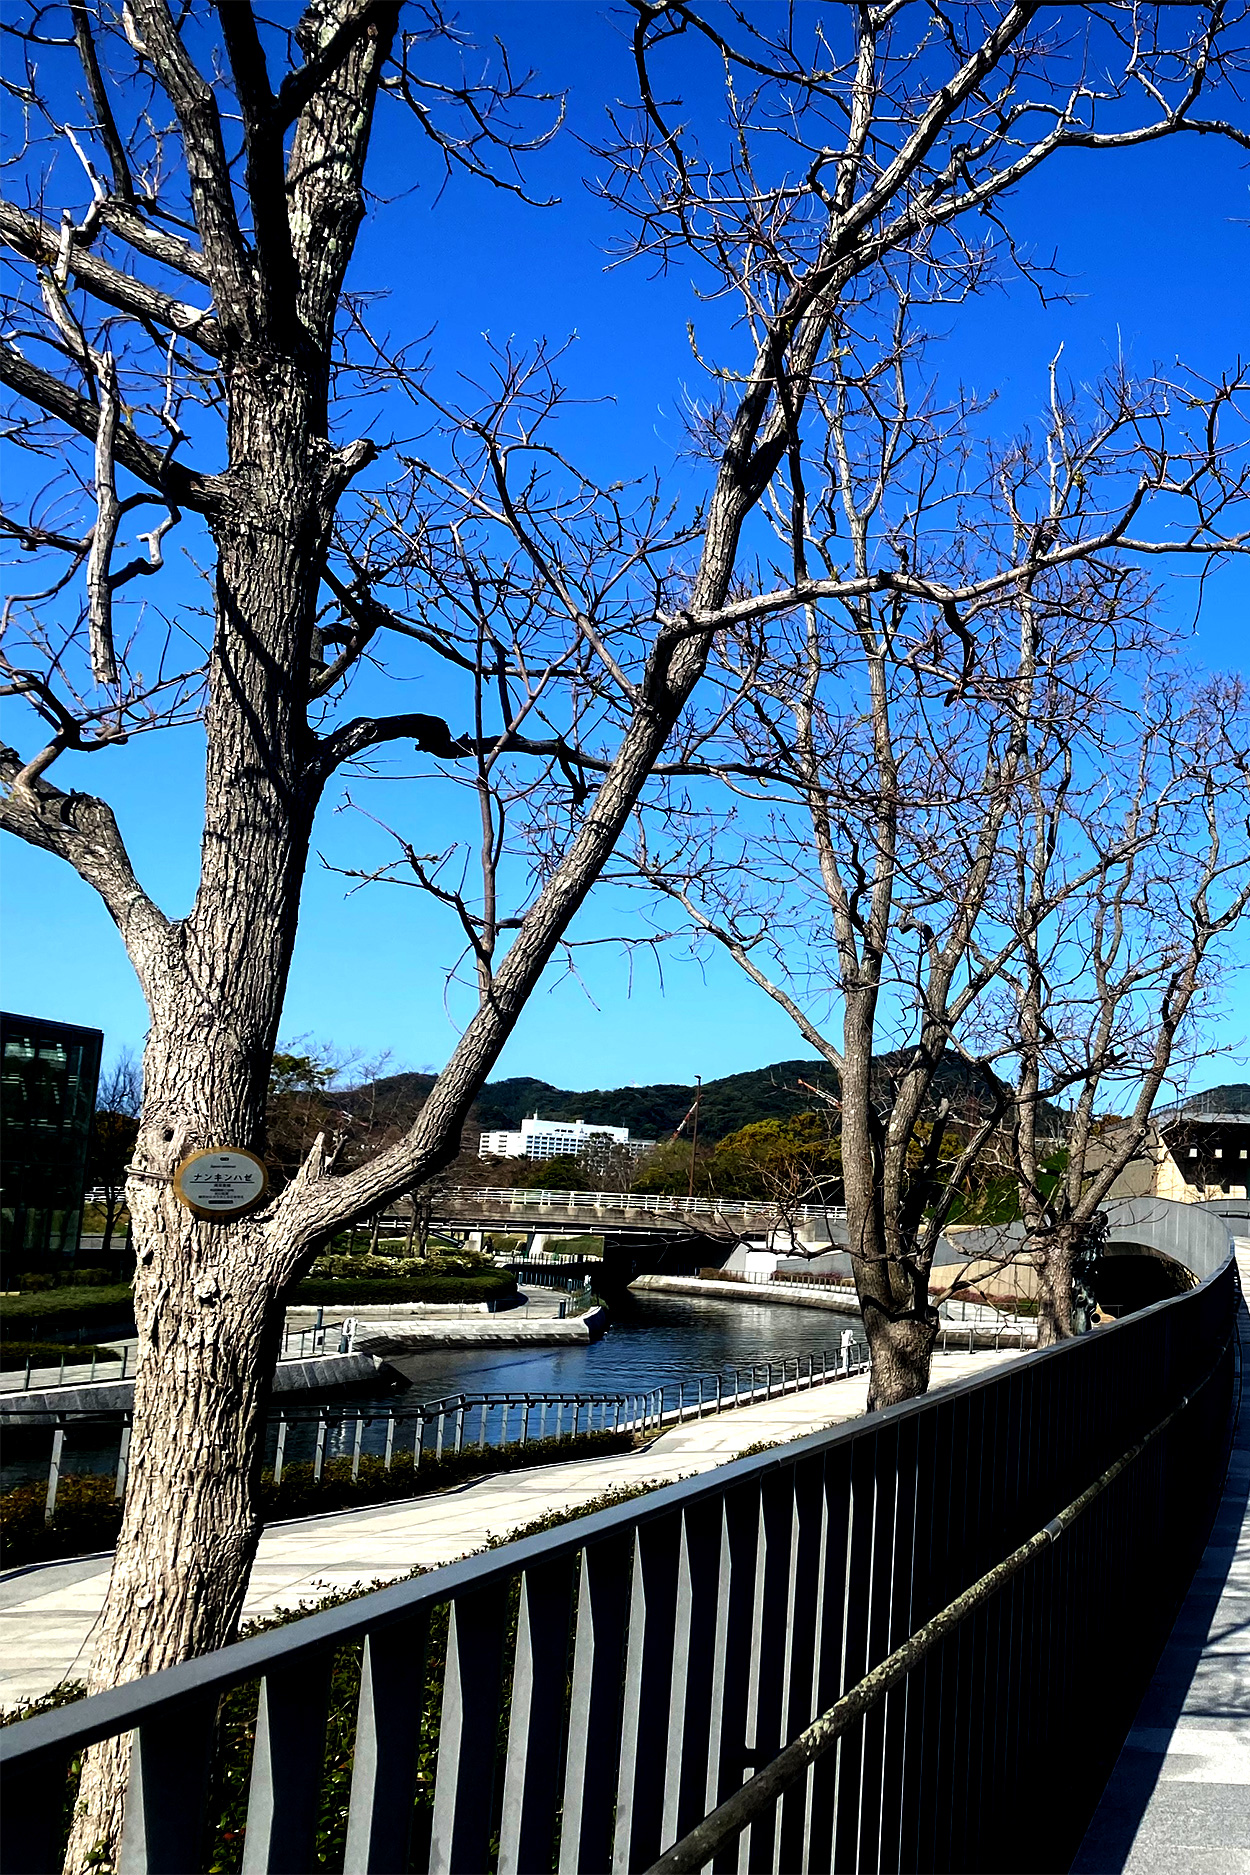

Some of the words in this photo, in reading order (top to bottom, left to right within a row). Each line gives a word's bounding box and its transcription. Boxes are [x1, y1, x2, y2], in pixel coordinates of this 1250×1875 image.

[193, 1173, 253, 1182] ナンキンハゼ
